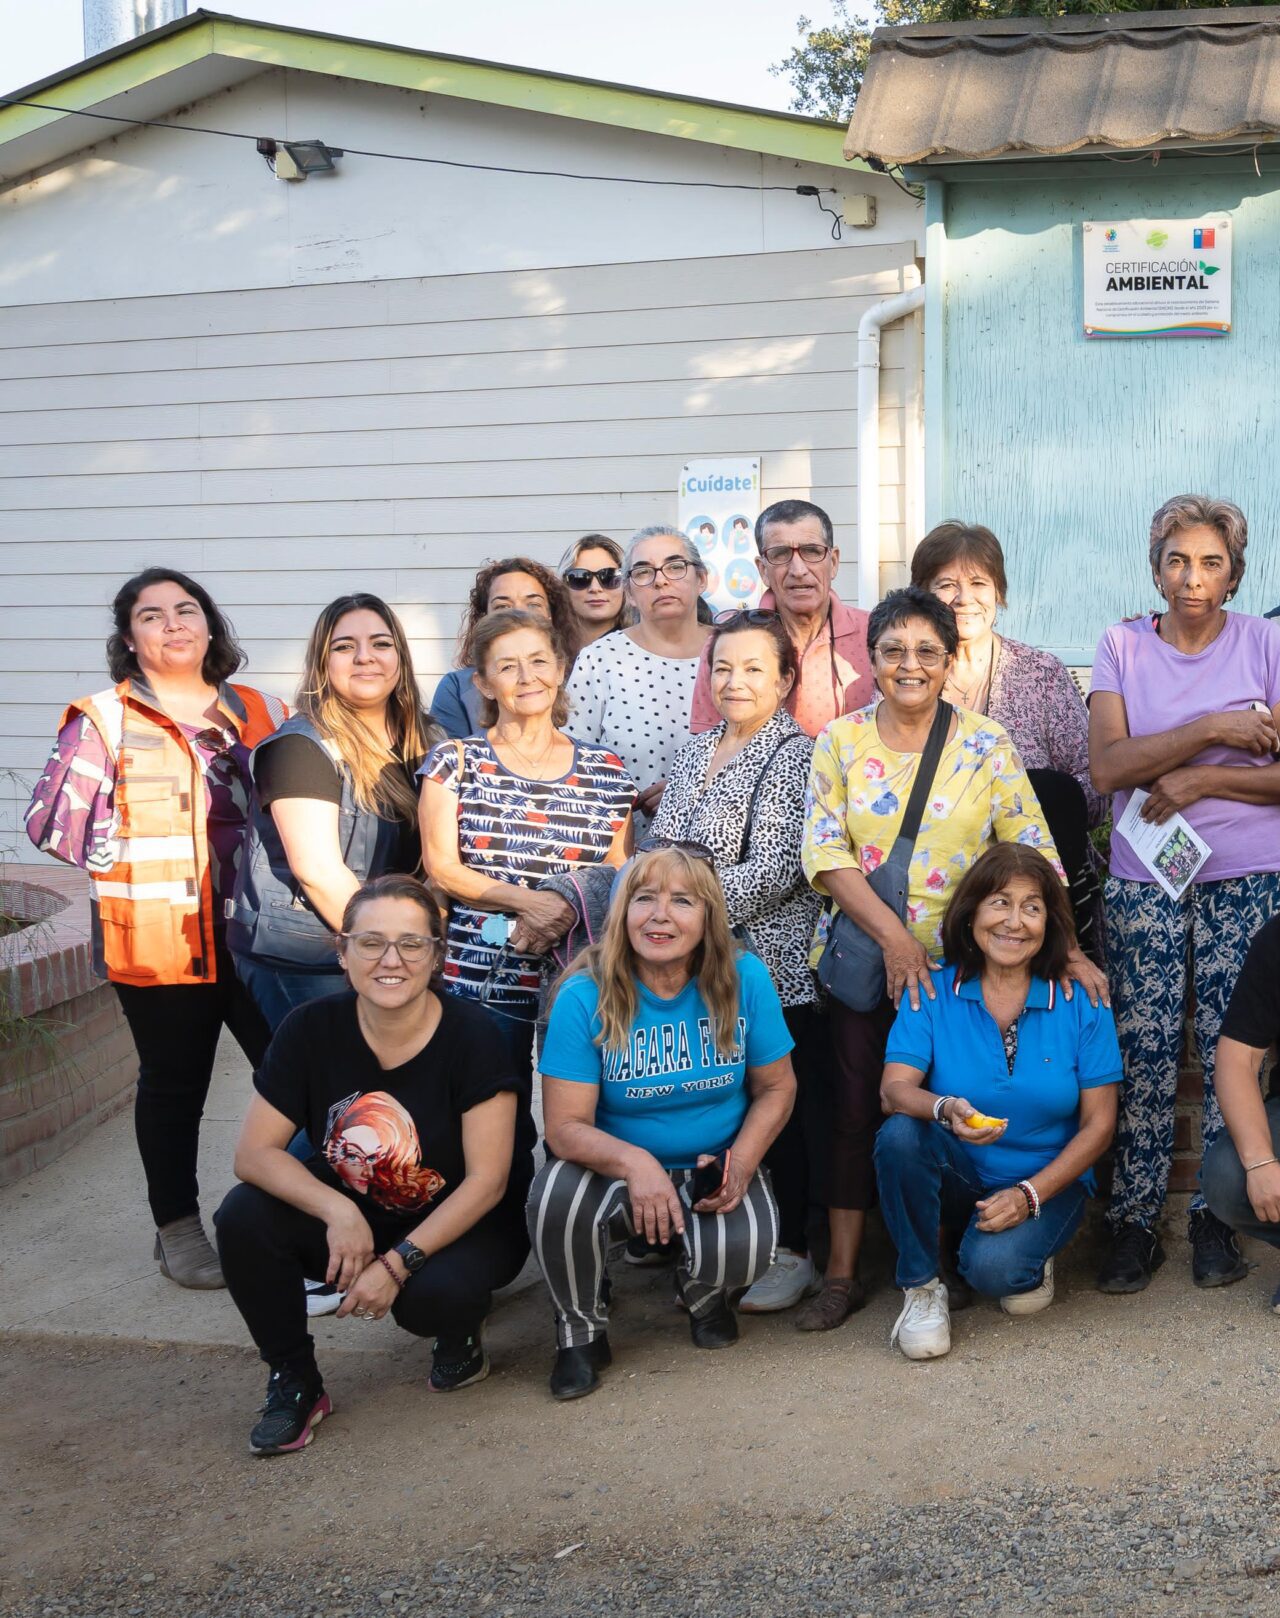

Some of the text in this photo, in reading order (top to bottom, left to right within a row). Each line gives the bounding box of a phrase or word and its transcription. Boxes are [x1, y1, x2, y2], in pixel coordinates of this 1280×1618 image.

[1105, 258, 1198, 274] CERTIFICACIÓN
[1105, 275, 1209, 292] AMBIENTAL
[681, 474, 757, 497] ¡Cuídate!
[625, 1072, 735, 1099] NEW YORK
